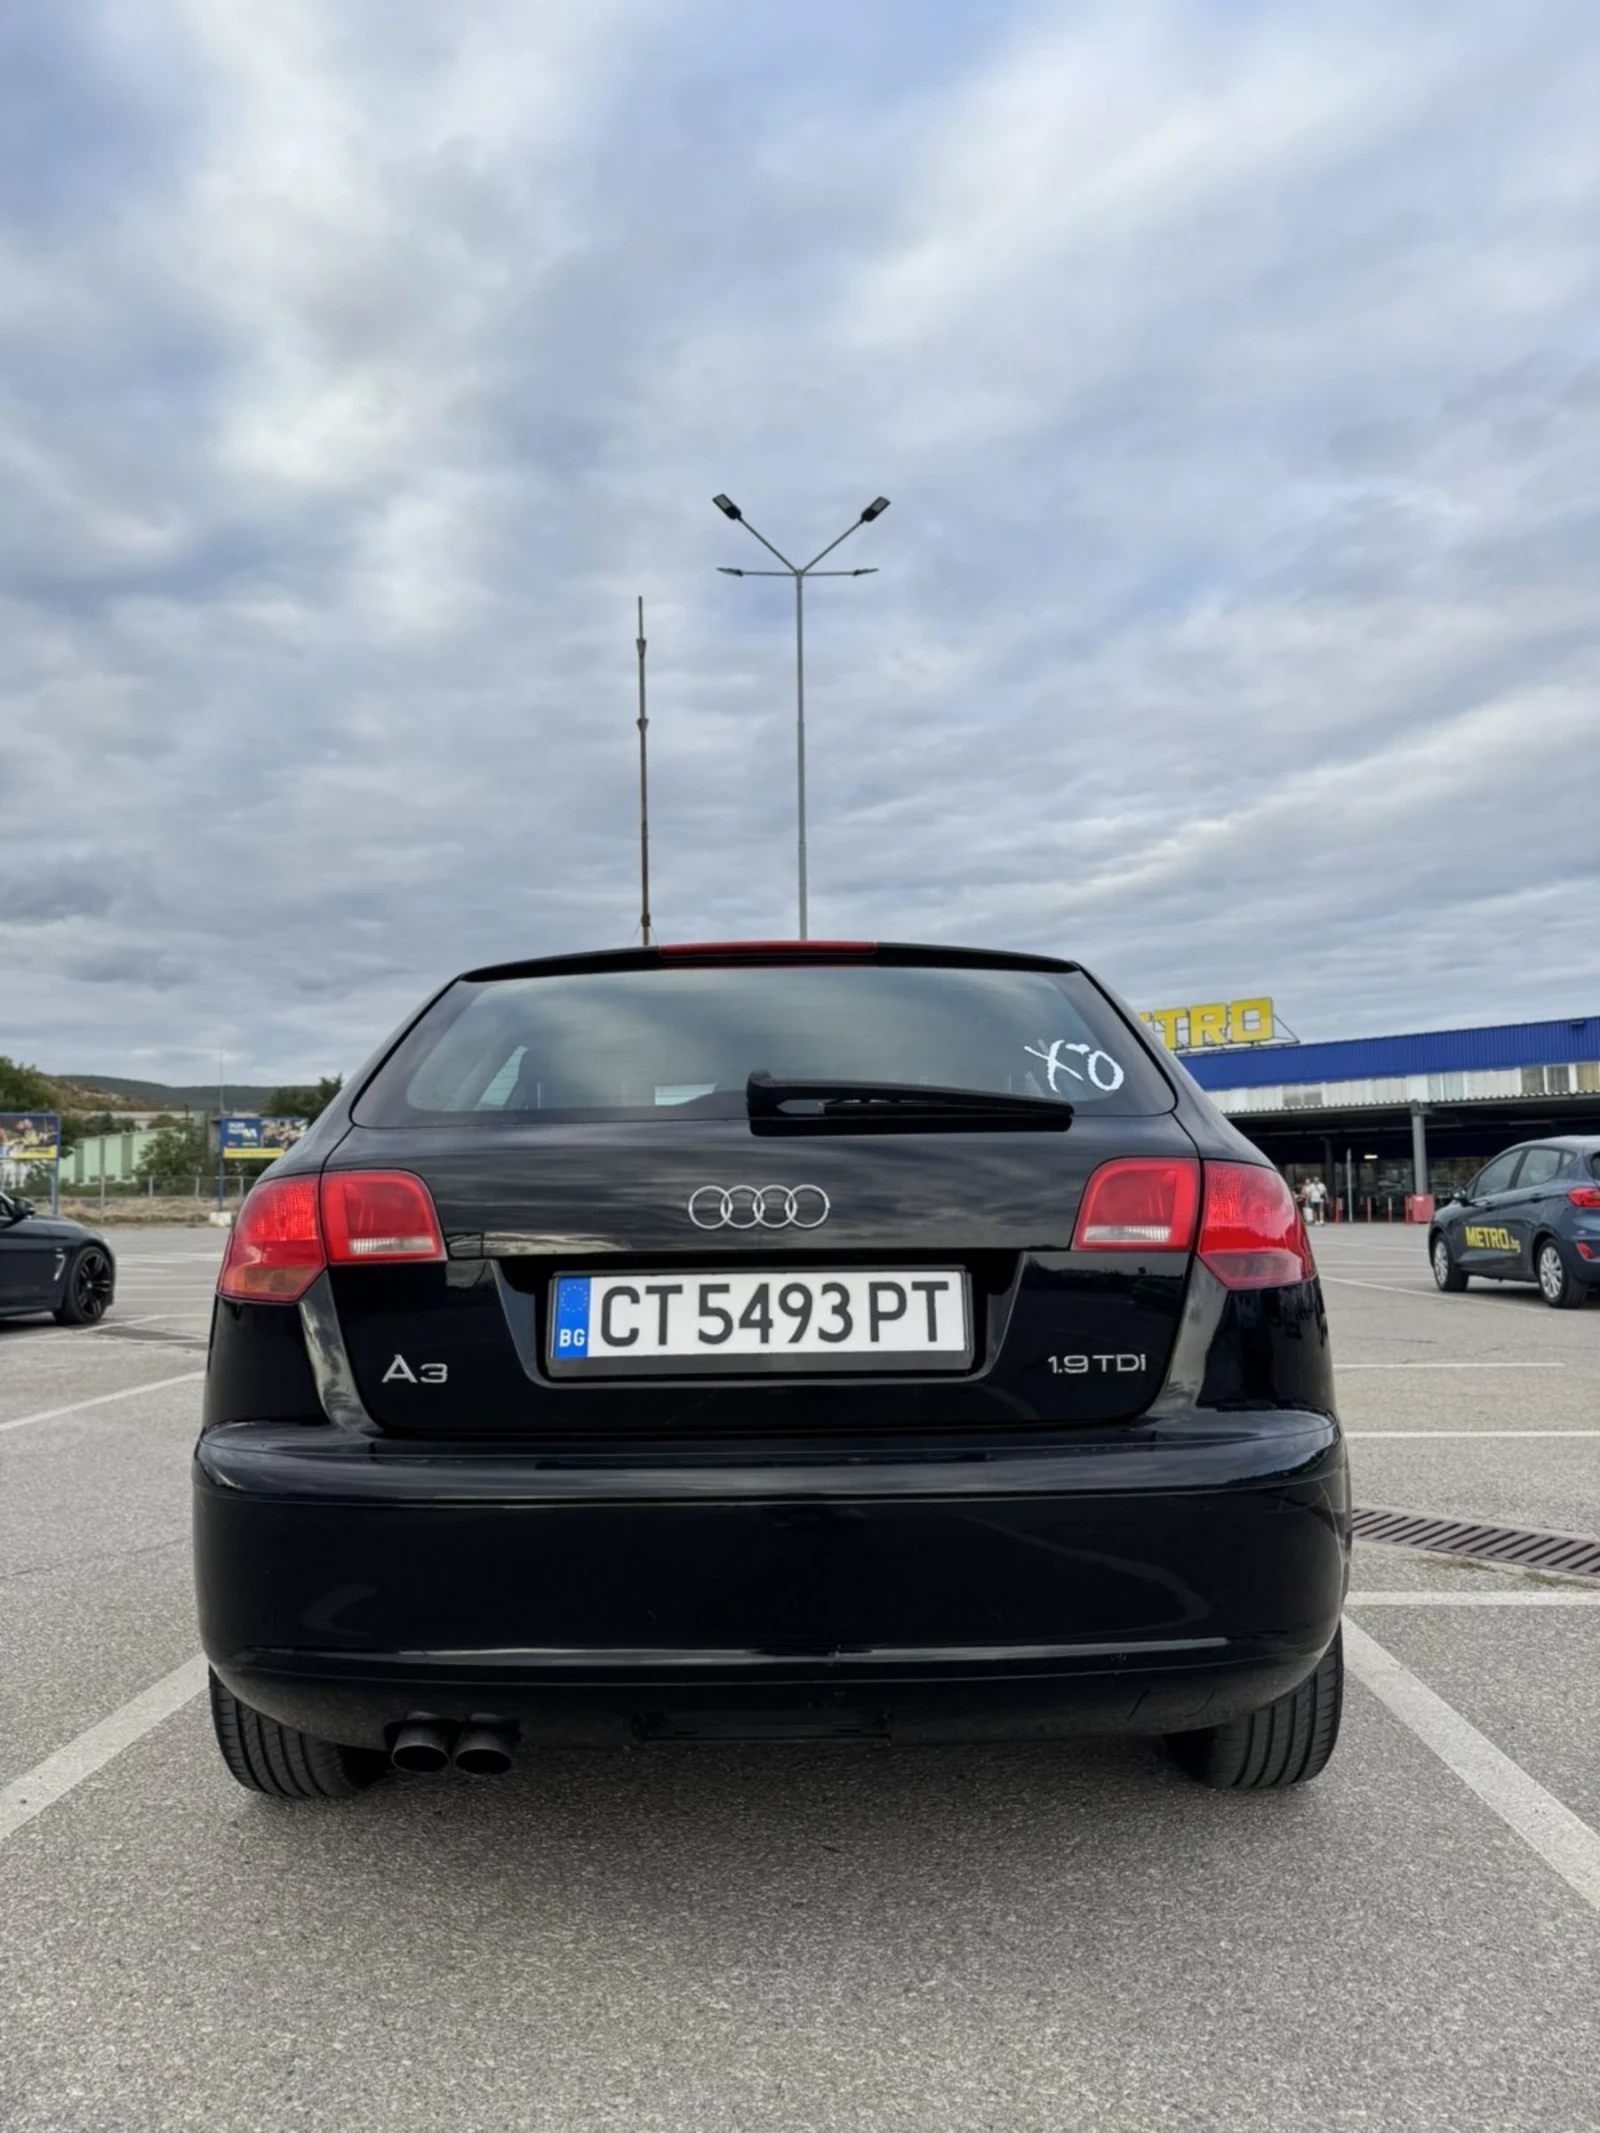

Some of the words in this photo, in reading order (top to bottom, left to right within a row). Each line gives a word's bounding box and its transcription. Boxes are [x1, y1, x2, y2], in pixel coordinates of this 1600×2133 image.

[1139, 997, 1273, 1051] TRO
[600, 1284, 684, 1348] CT
[697, 1281, 854, 1345] 5493
[867, 1280, 949, 1343] PT
[559, 1328, 586, 1348] BG
[381, 1353, 449, 1384] A3
